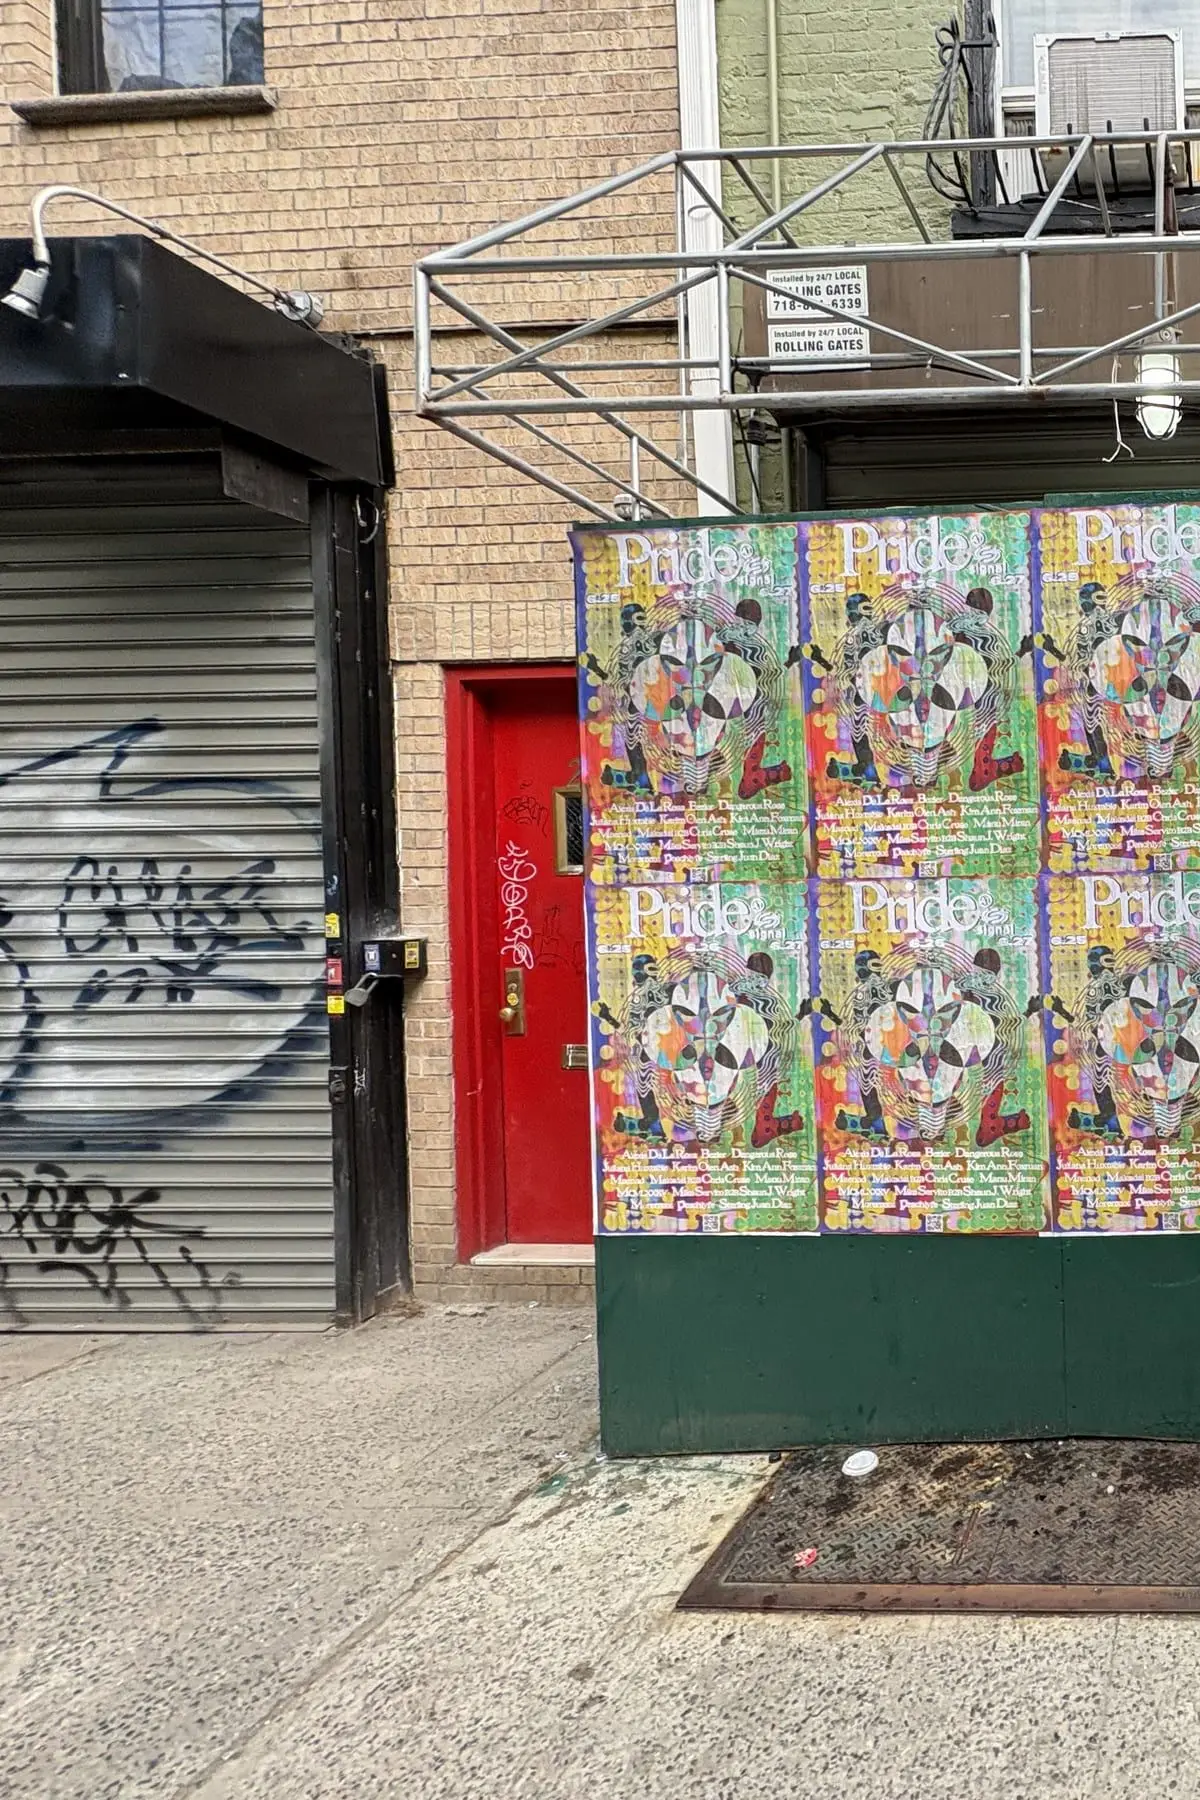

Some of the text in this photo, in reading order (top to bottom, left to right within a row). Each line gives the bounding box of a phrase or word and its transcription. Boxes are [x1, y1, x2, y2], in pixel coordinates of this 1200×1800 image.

[772, 271, 862, 283] Installed by 24/7 LOCAL
[826, 283, 862, 296] GATES
[774, 327, 864, 338] Installed by 24/7 LOCAL
[775, 339, 864, 353] ROLLING GATES
[836, 514, 971, 579] Pride
[611, 527, 741, 589] Pride
[960, 804, 979, 815] Kim
[980, 804, 1001, 815] Ann
[730, 812, 748, 823] Kim
[749, 812, 769, 822] Ann
[622, 882, 752, 940] Pride
[846, 876, 980, 935] Pride
[742, 1161, 761, 1171] Kim
[761, 1161, 782, 1171] Ann
[967, 1160, 985, 1170] Kim
[986, 1160, 1007, 1170] Ann
